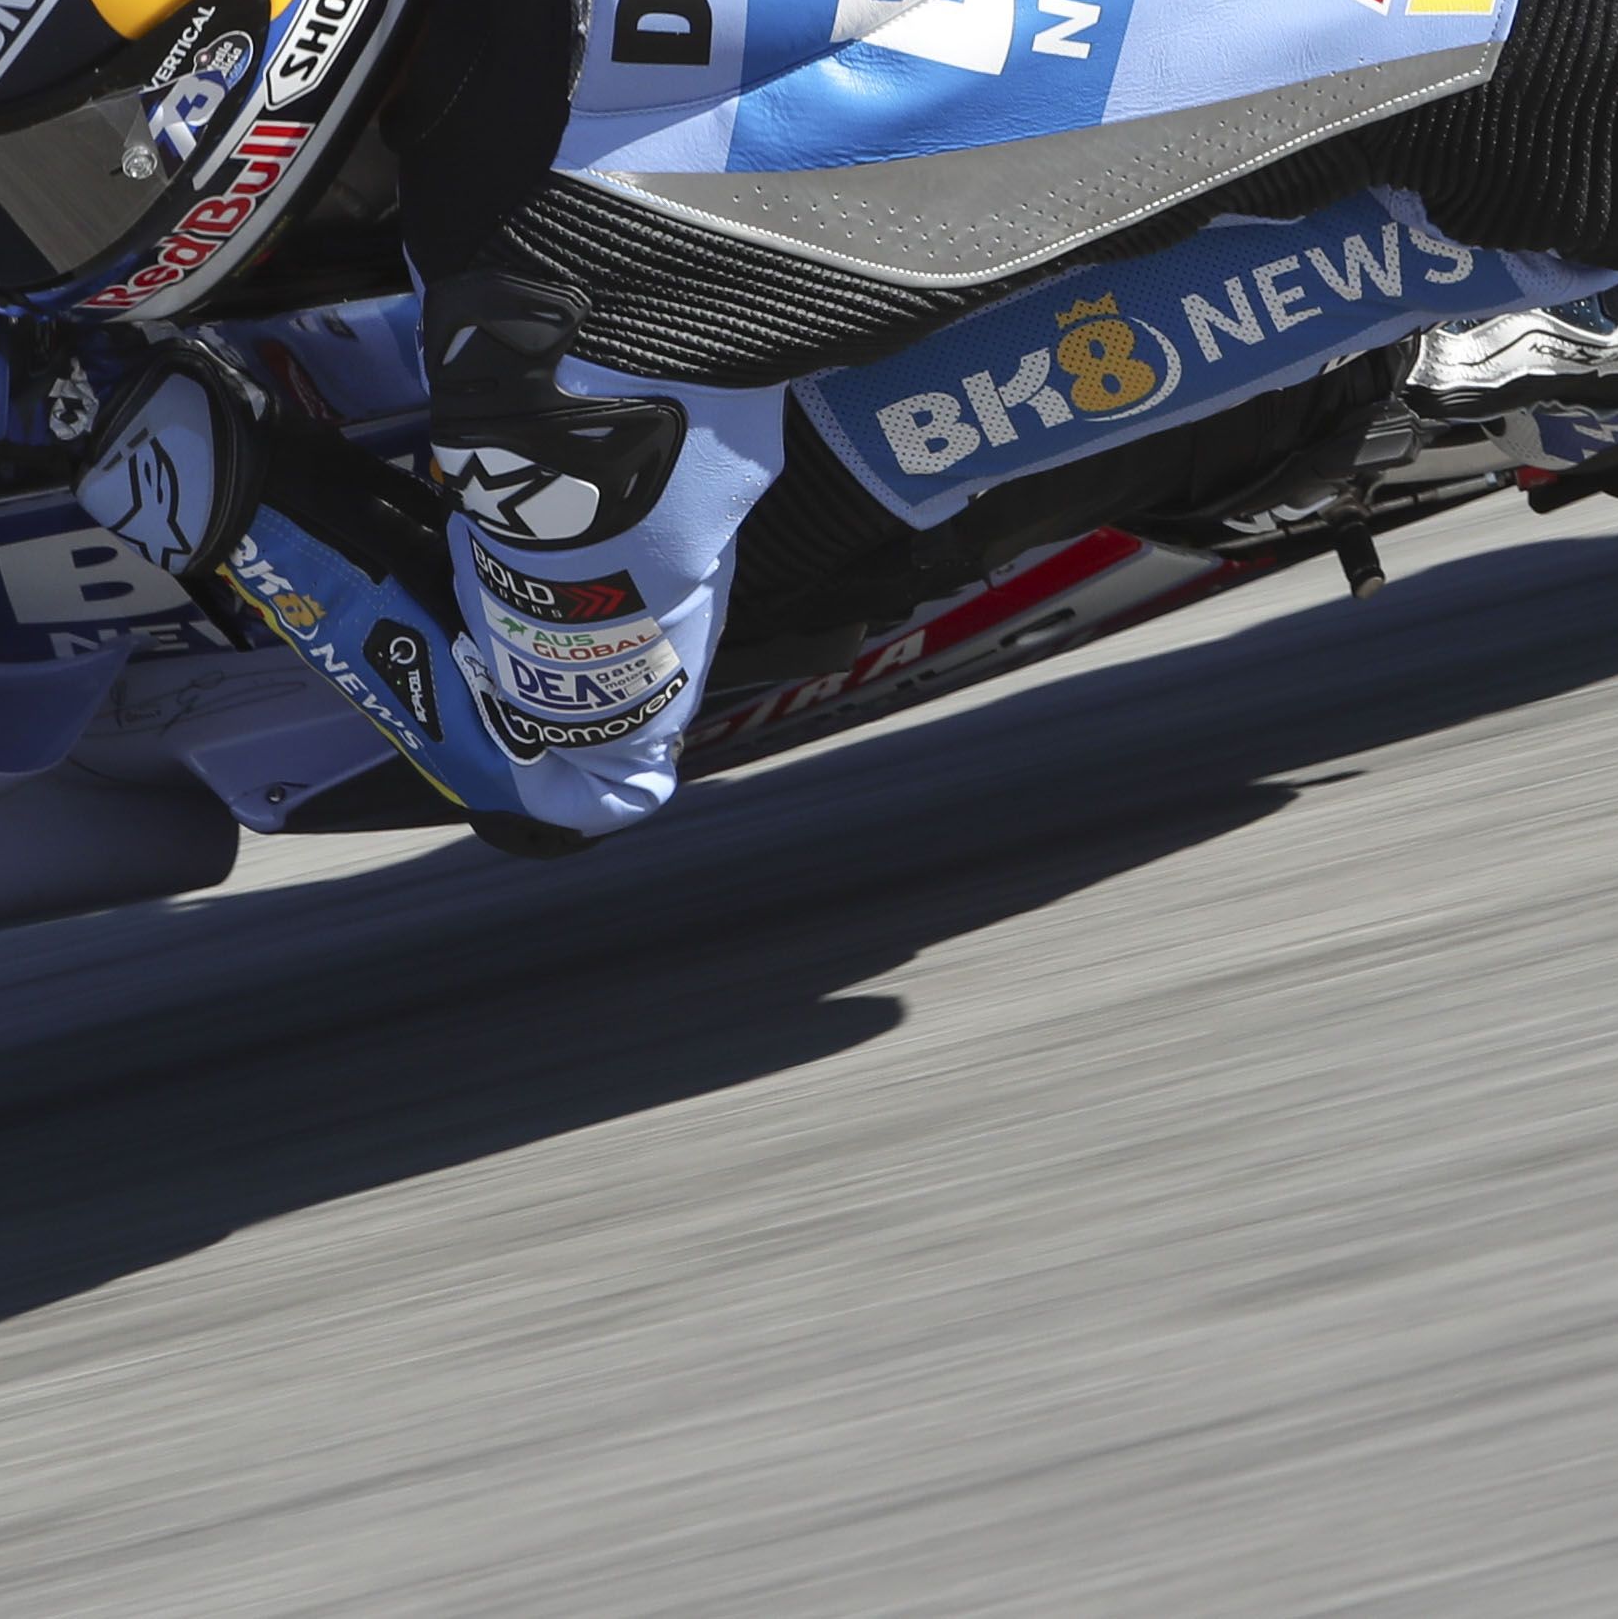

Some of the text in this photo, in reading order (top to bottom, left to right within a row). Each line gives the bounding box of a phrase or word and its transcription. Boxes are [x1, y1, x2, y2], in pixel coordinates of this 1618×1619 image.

[142, 5, 217, 93] VERTICAL
[875, 220, 1475, 479] BK8 NEWS
[472, 540, 557, 606] BOLD
[532, 630, 595, 648] AUS
[532, 633, 659, 662] GLOBAL
[594, 657, 649, 686] gate
[309, 642, 426, 751] NEWS
[507, 652, 617, 710] DEA
[509, 675, 685, 744] momoven
